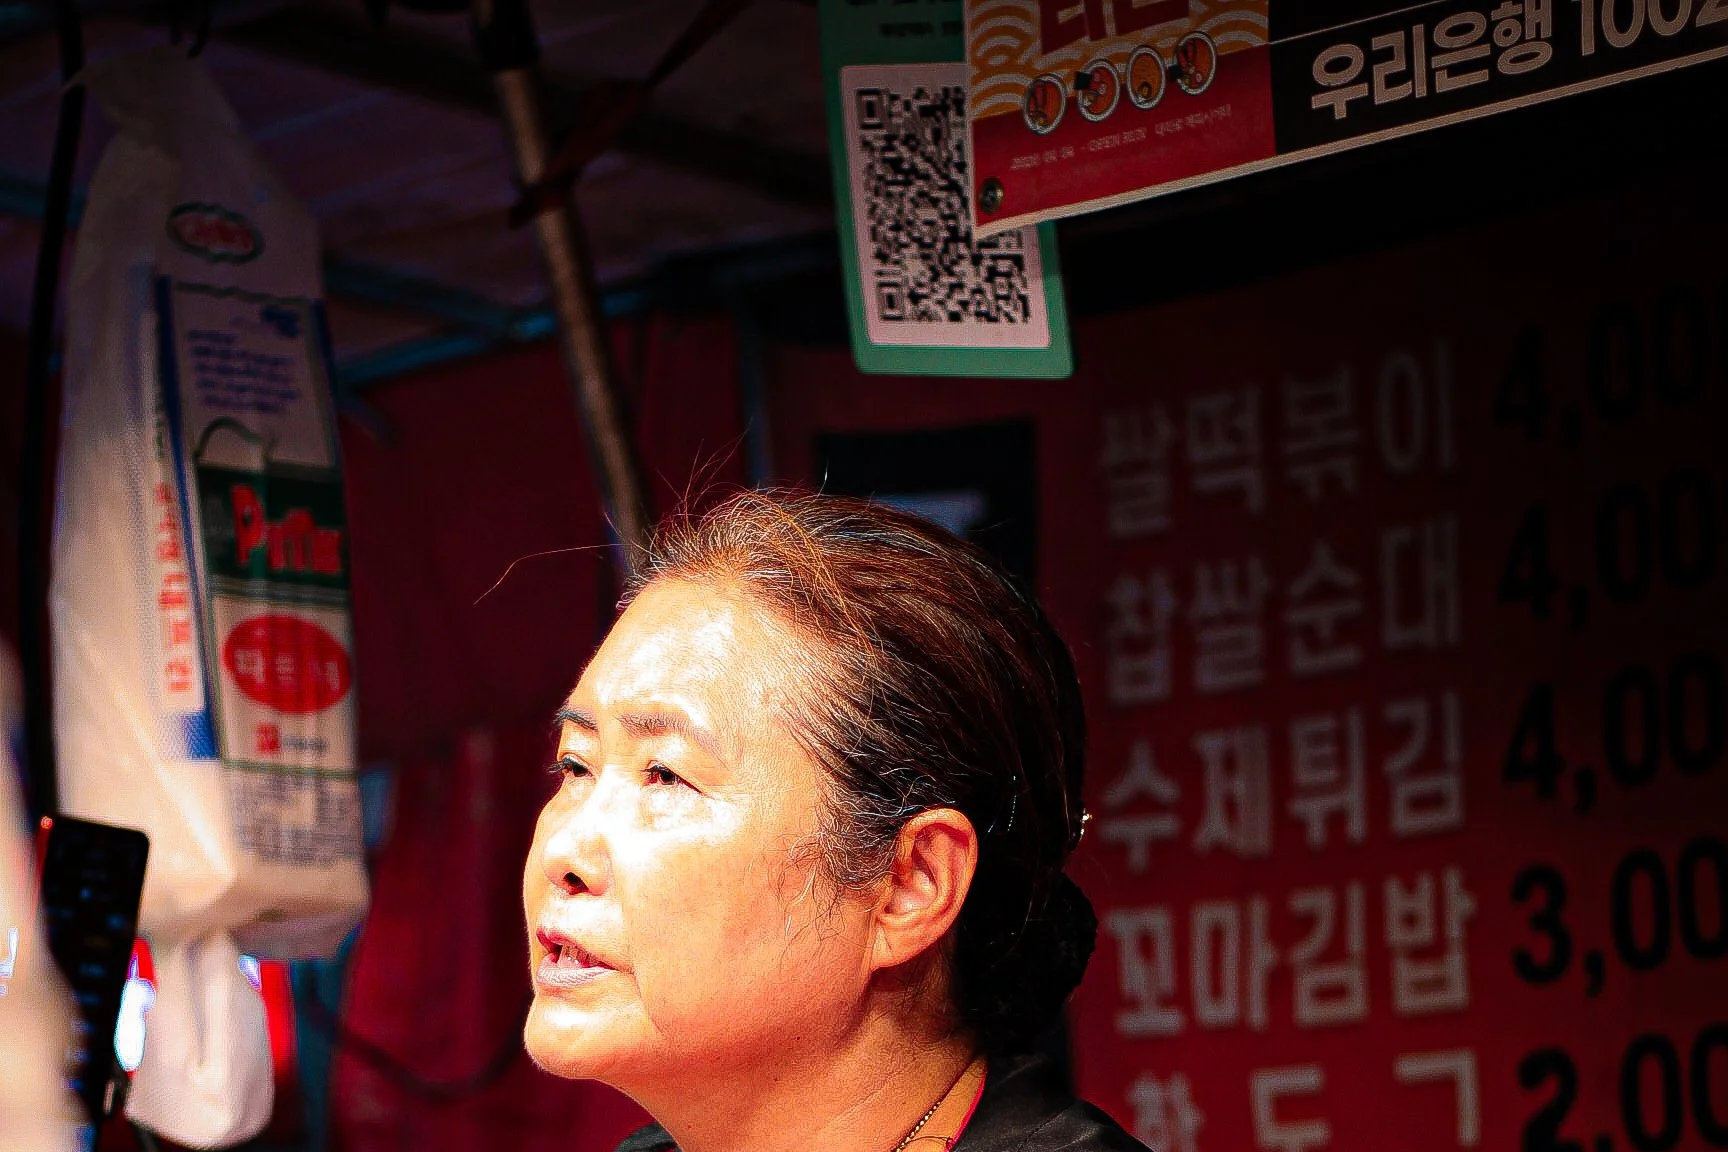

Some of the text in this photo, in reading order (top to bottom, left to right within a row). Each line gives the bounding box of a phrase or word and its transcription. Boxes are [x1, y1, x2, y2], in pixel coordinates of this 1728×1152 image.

[1311, 0, 1553, 120] 우리은행
[1099, 276, 1728, 540] 쌀떡볶이 4,00
[1103, 467, 1728, 710] 찹쌀순대 4,00
[1099, 690, 1466, 874] 수제튀김
[1103, 864, 1478, 1040] 꼬마김밥
